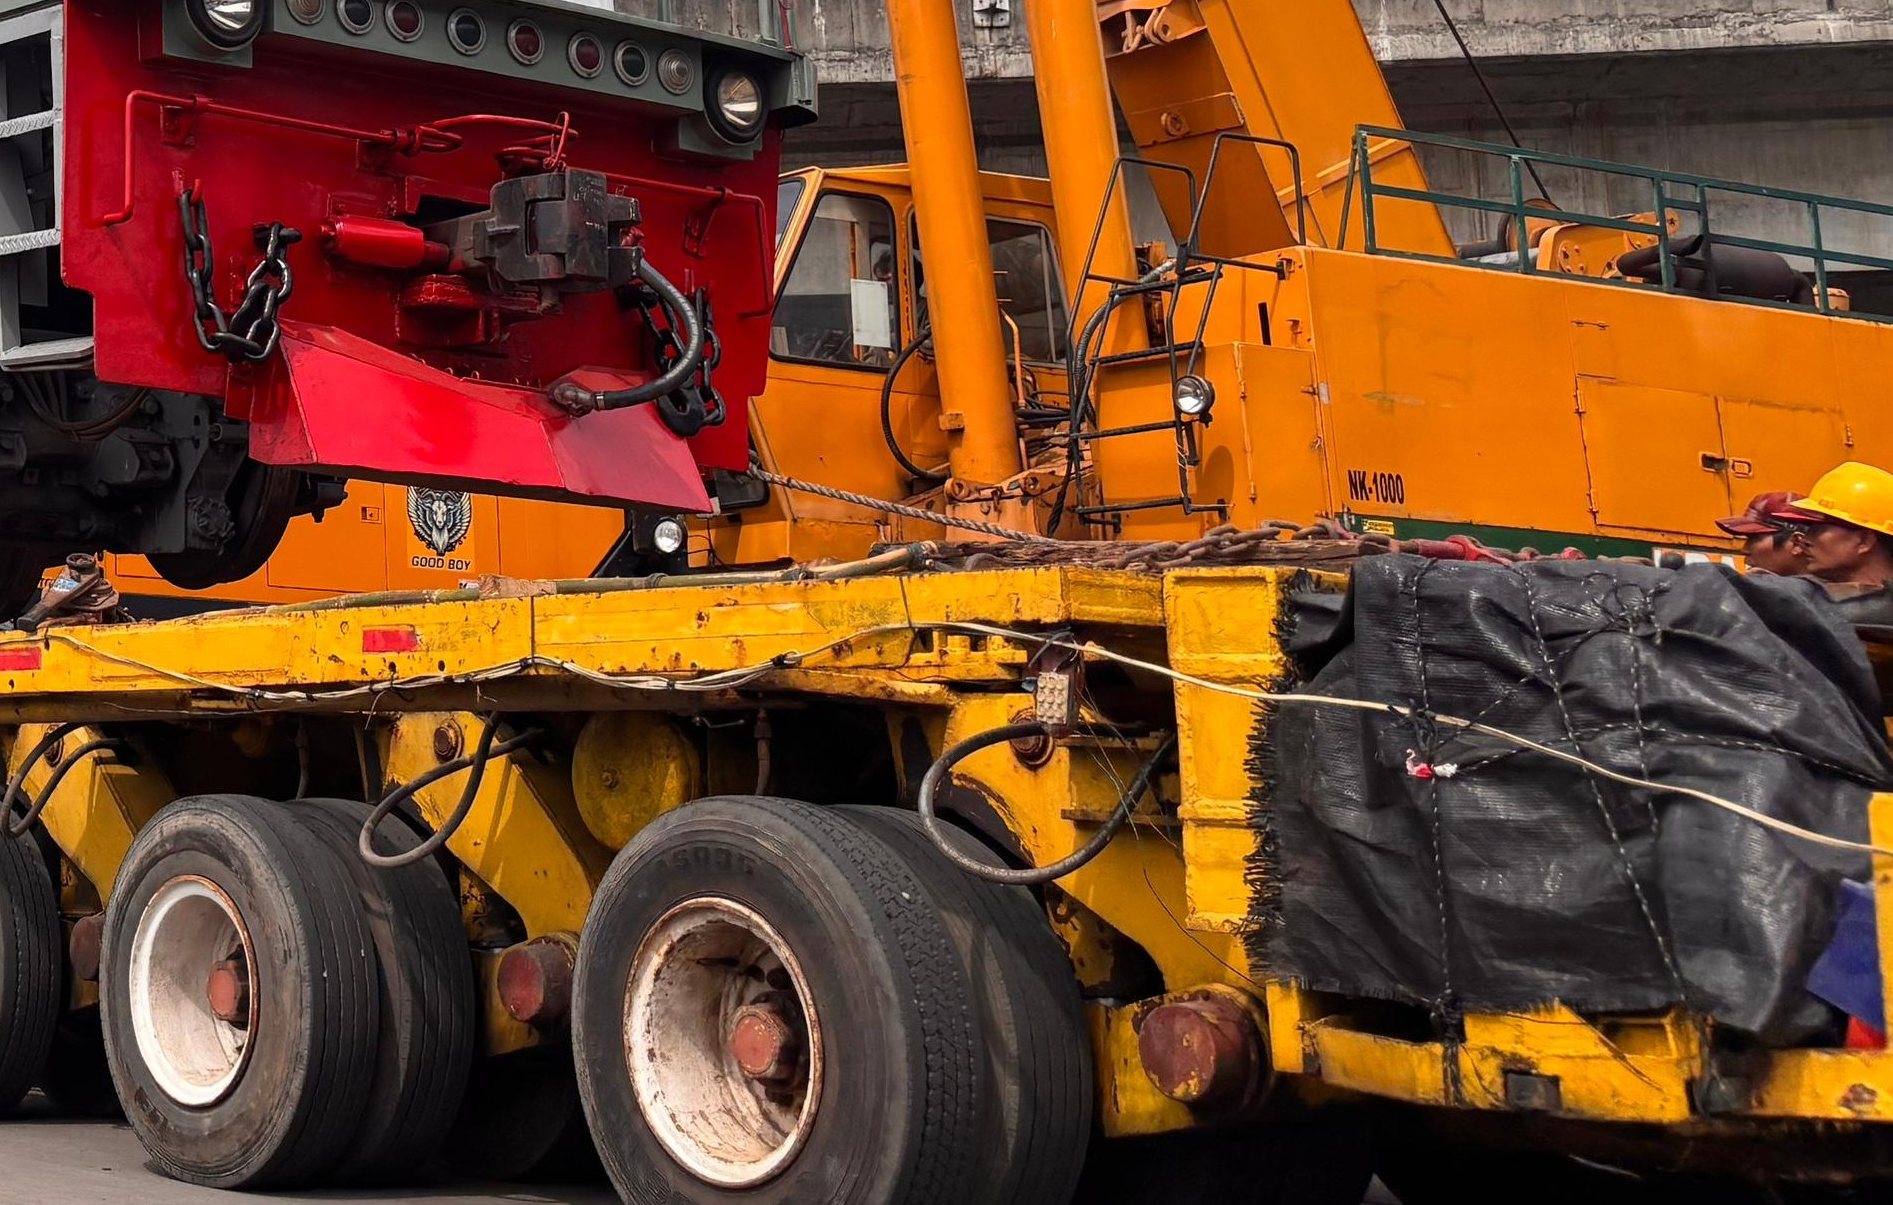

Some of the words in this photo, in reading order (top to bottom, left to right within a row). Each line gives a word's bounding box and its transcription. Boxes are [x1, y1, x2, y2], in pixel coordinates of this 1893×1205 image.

[1348, 469, 1404, 505] NK-1000
[412, 556, 444, 569] GOOD
[448, 559, 471, 570] BOY
